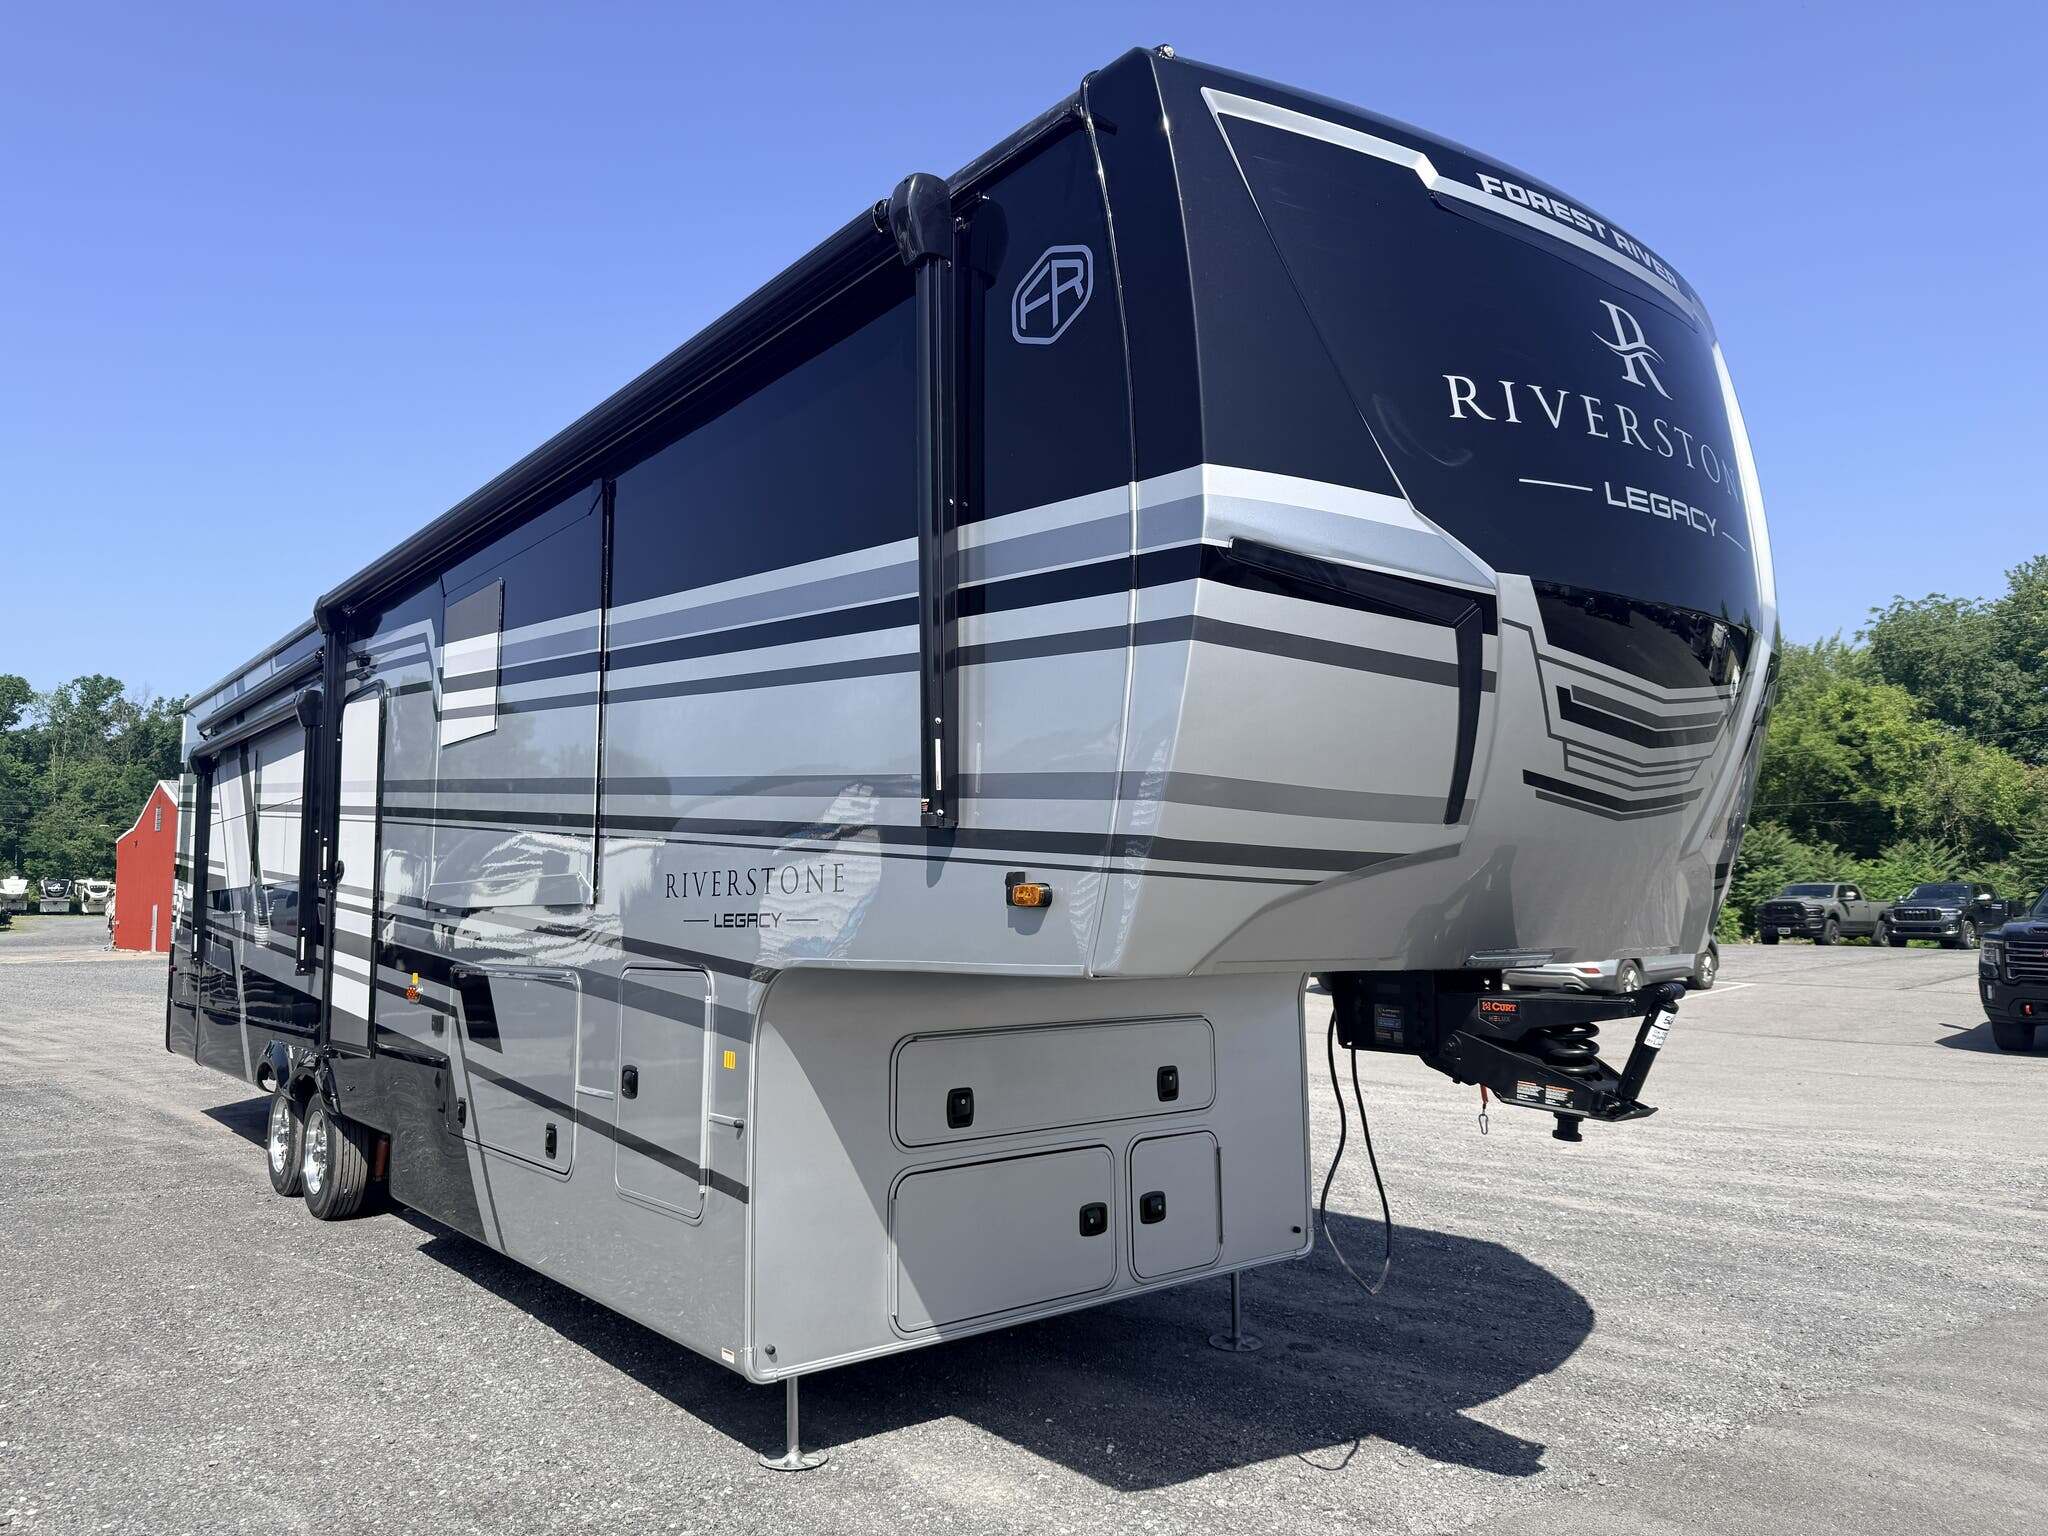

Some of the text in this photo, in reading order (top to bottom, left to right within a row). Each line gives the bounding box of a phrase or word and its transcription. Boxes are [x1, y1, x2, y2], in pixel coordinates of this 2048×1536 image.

[1475, 172, 1680, 292] FOREST RIVER
[1441, 373, 1740, 504] RIVERSTON
[1604, 481, 1718, 538] LEGACY
[664, 862, 846, 899] RIVERSTONE
[713, 911, 783, 929] LEGACY
